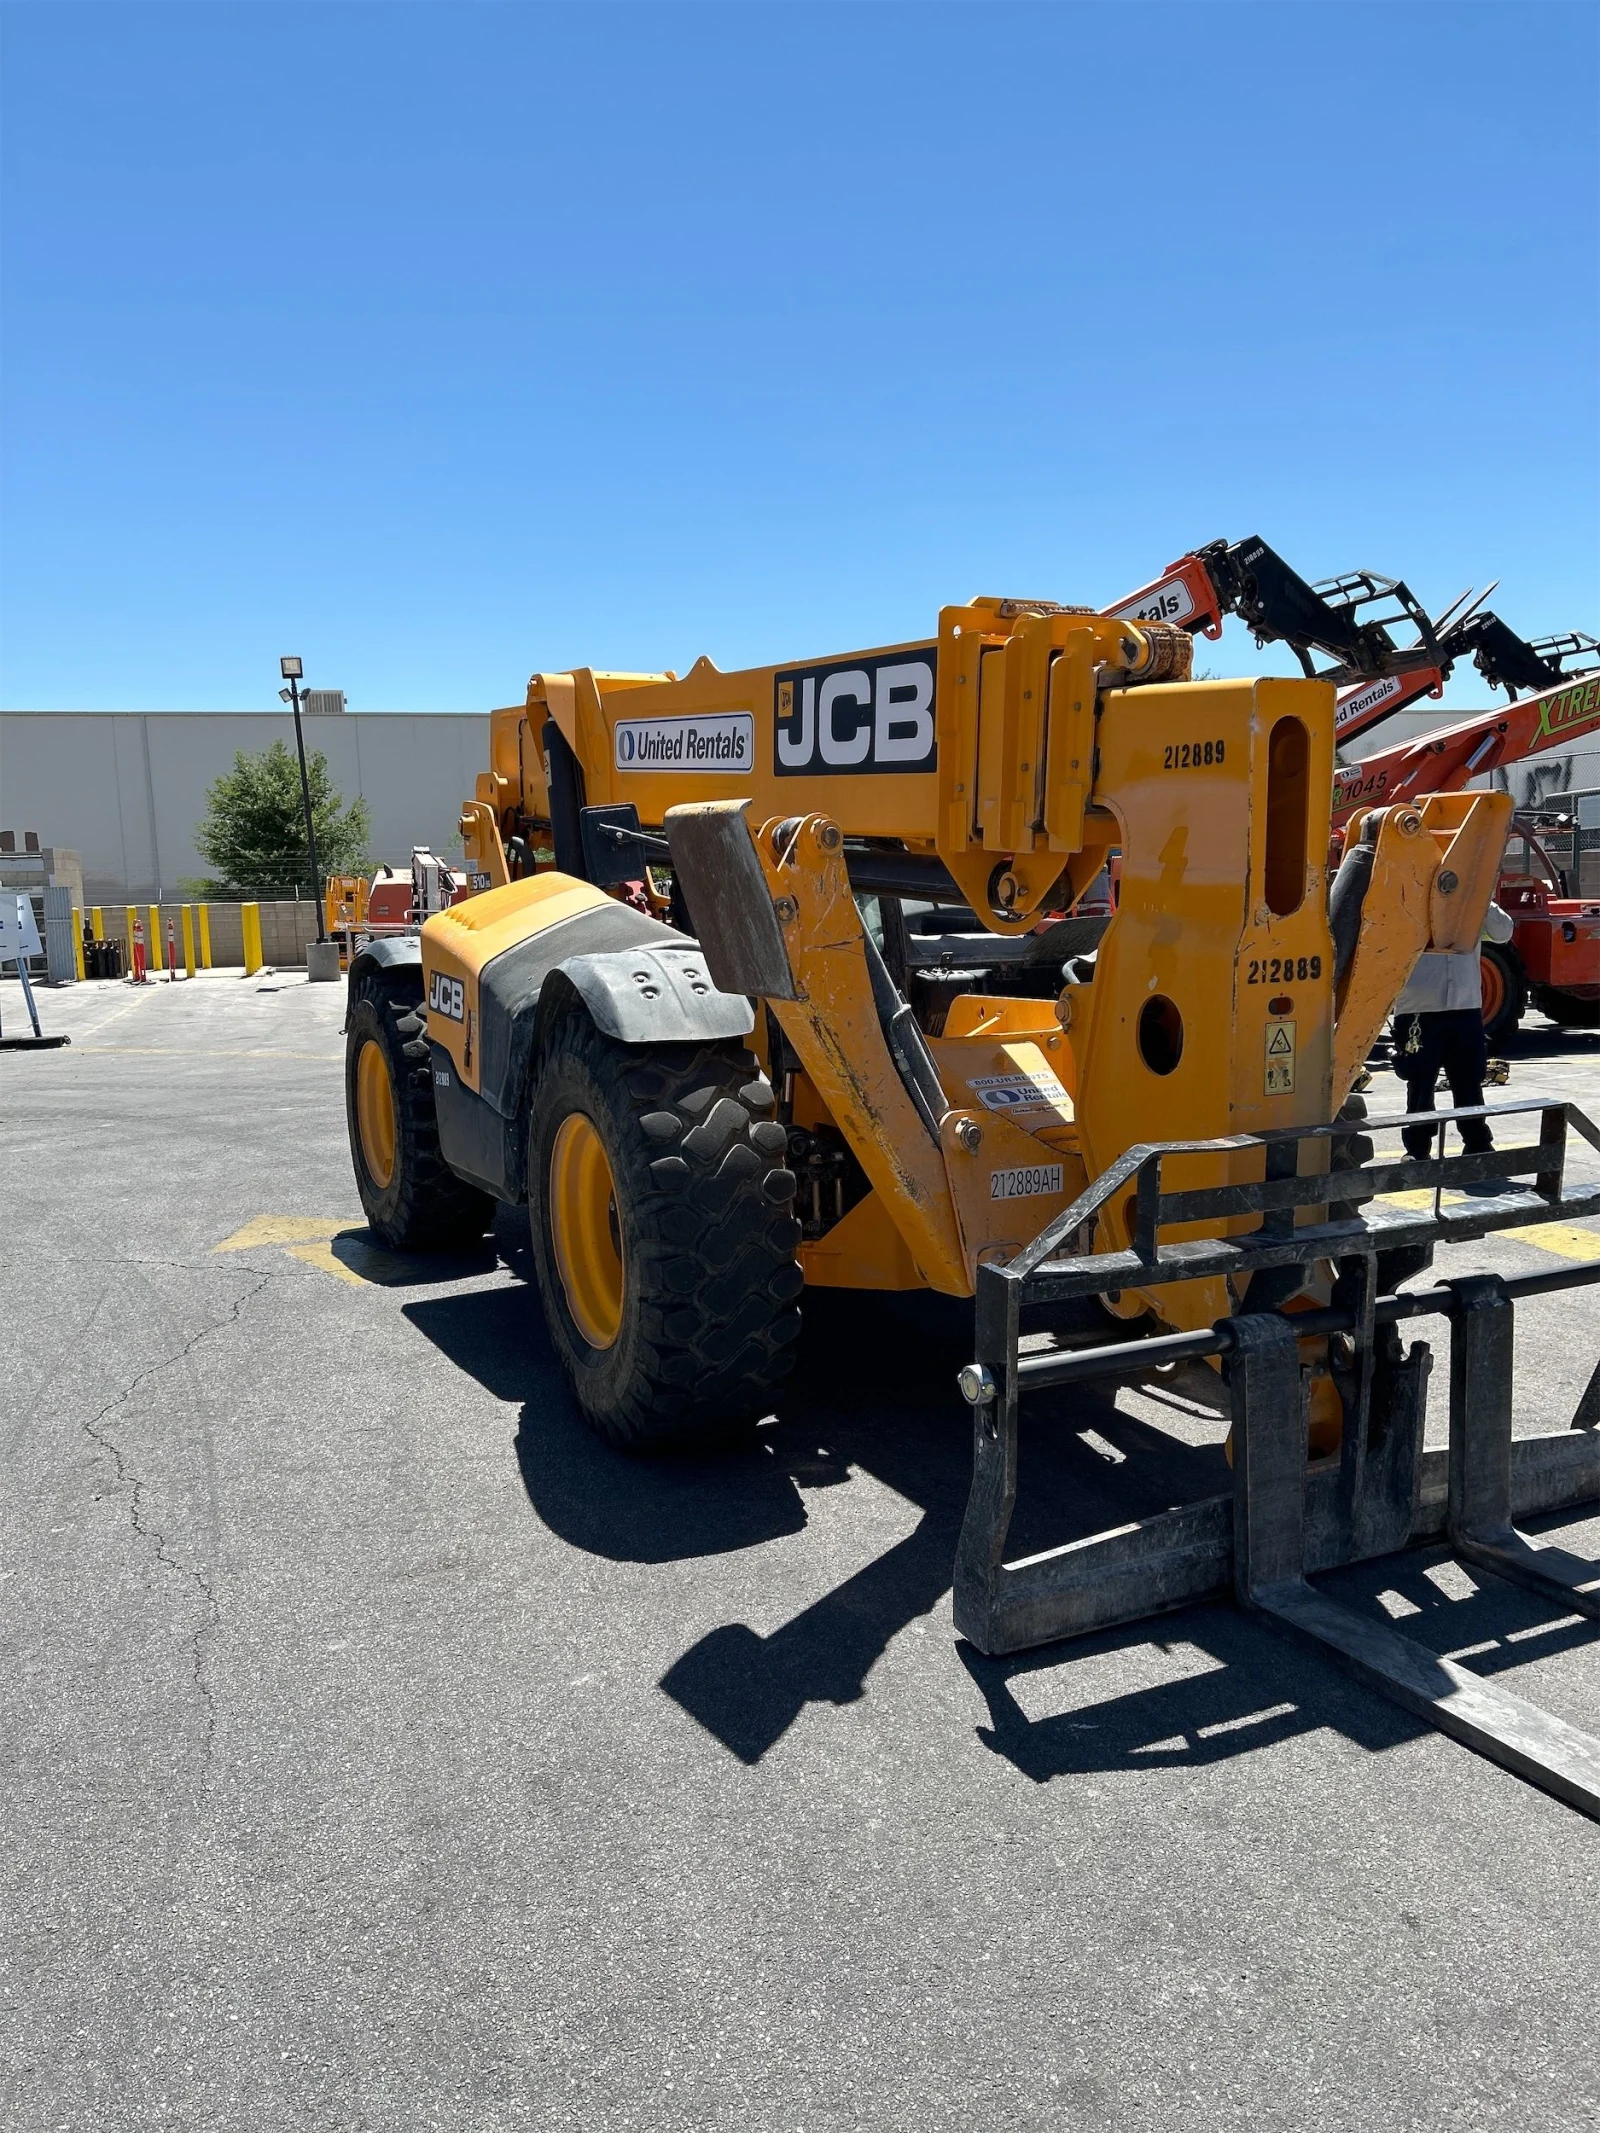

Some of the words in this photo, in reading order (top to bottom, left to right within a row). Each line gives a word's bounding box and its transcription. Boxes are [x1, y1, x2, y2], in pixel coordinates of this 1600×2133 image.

[1137, 595, 1180, 620] tals
[778, 662, 934, 767] JCB
[1349, 682, 1394, 716] Rentals
[1529, 677, 1600, 749] XTRE
[637, 729, 684, 761] United
[686, 726, 746, 760] Rentals
[1164, 739, 1225, 769] 212889
[1247, 955, 1322, 985] 212889
[430, 973, 464, 1020] JCB
[1017, 1084, 1059, 1095] United
[1024, 1092, 1068, 1102] Rentals
[991, 1166, 1060, 1198] 212889AH
